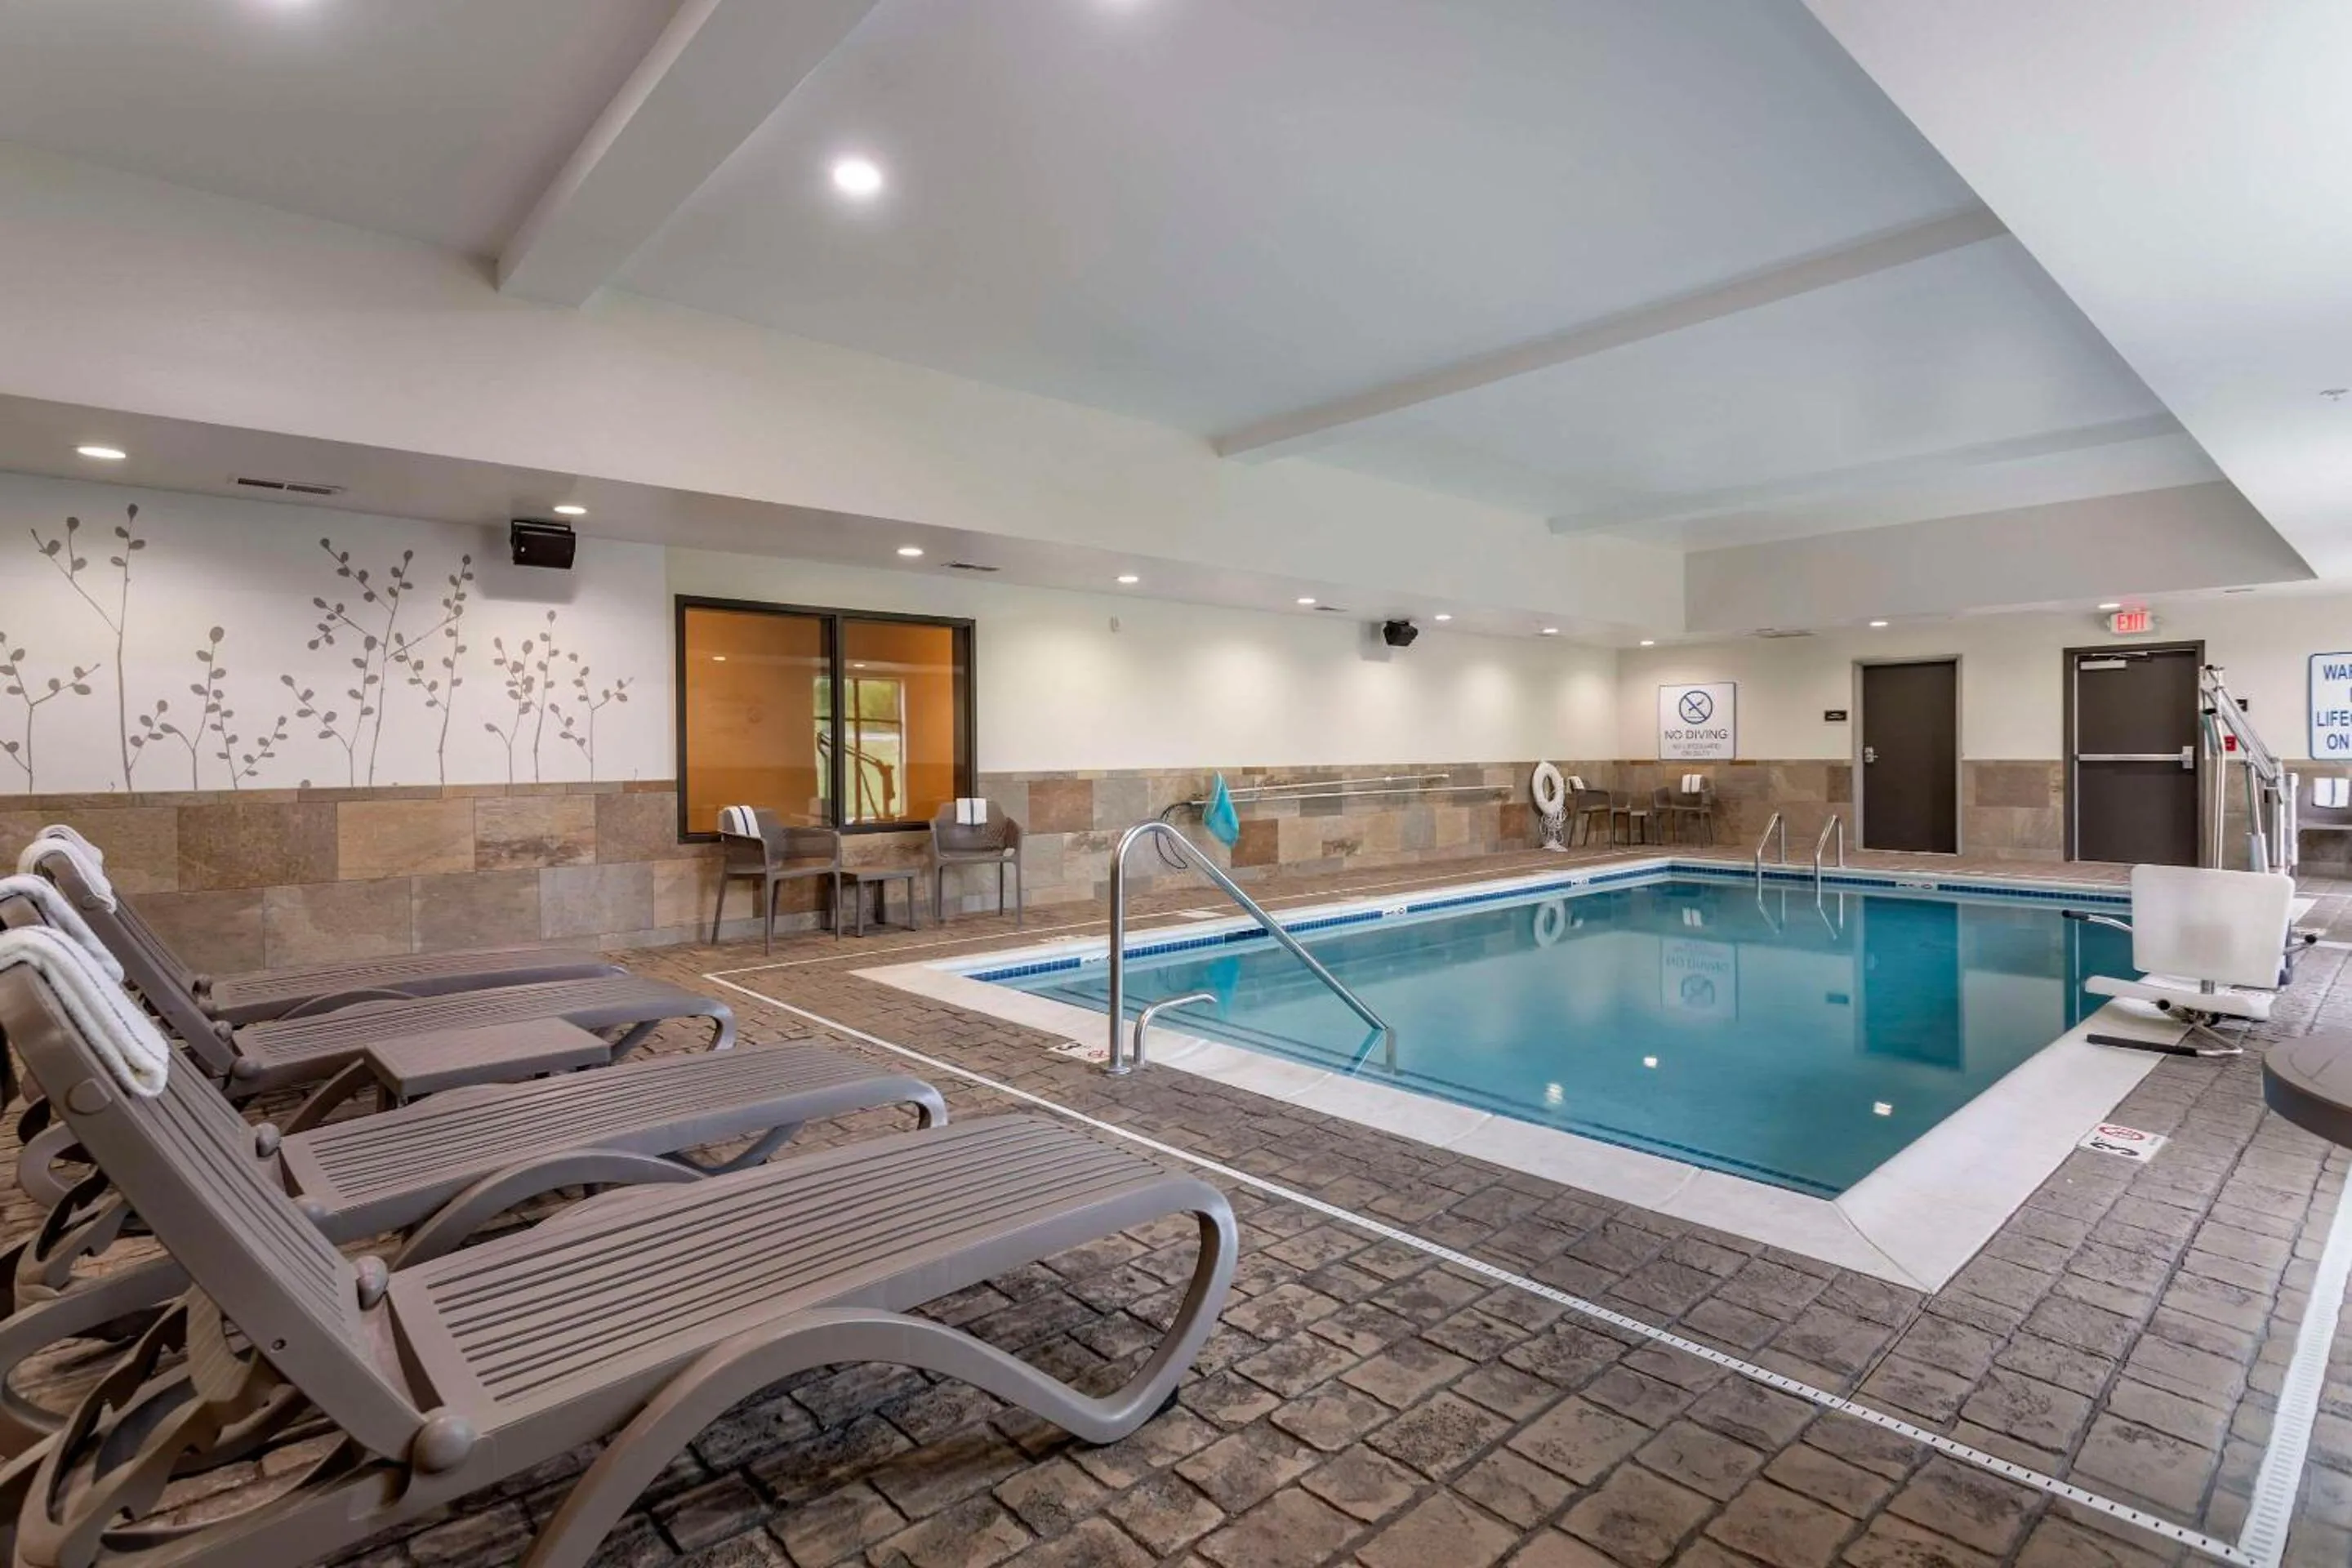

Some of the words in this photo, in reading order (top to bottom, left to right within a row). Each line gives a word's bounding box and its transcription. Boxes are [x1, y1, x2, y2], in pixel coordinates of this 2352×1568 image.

[2117, 613, 2146, 630] EXIT
[2317, 710, 2352, 727] LIFE
[1664, 730, 1683, 739] NO
[1686, 728, 1728, 739] DIVING
[2327, 733, 2350, 750] ON
